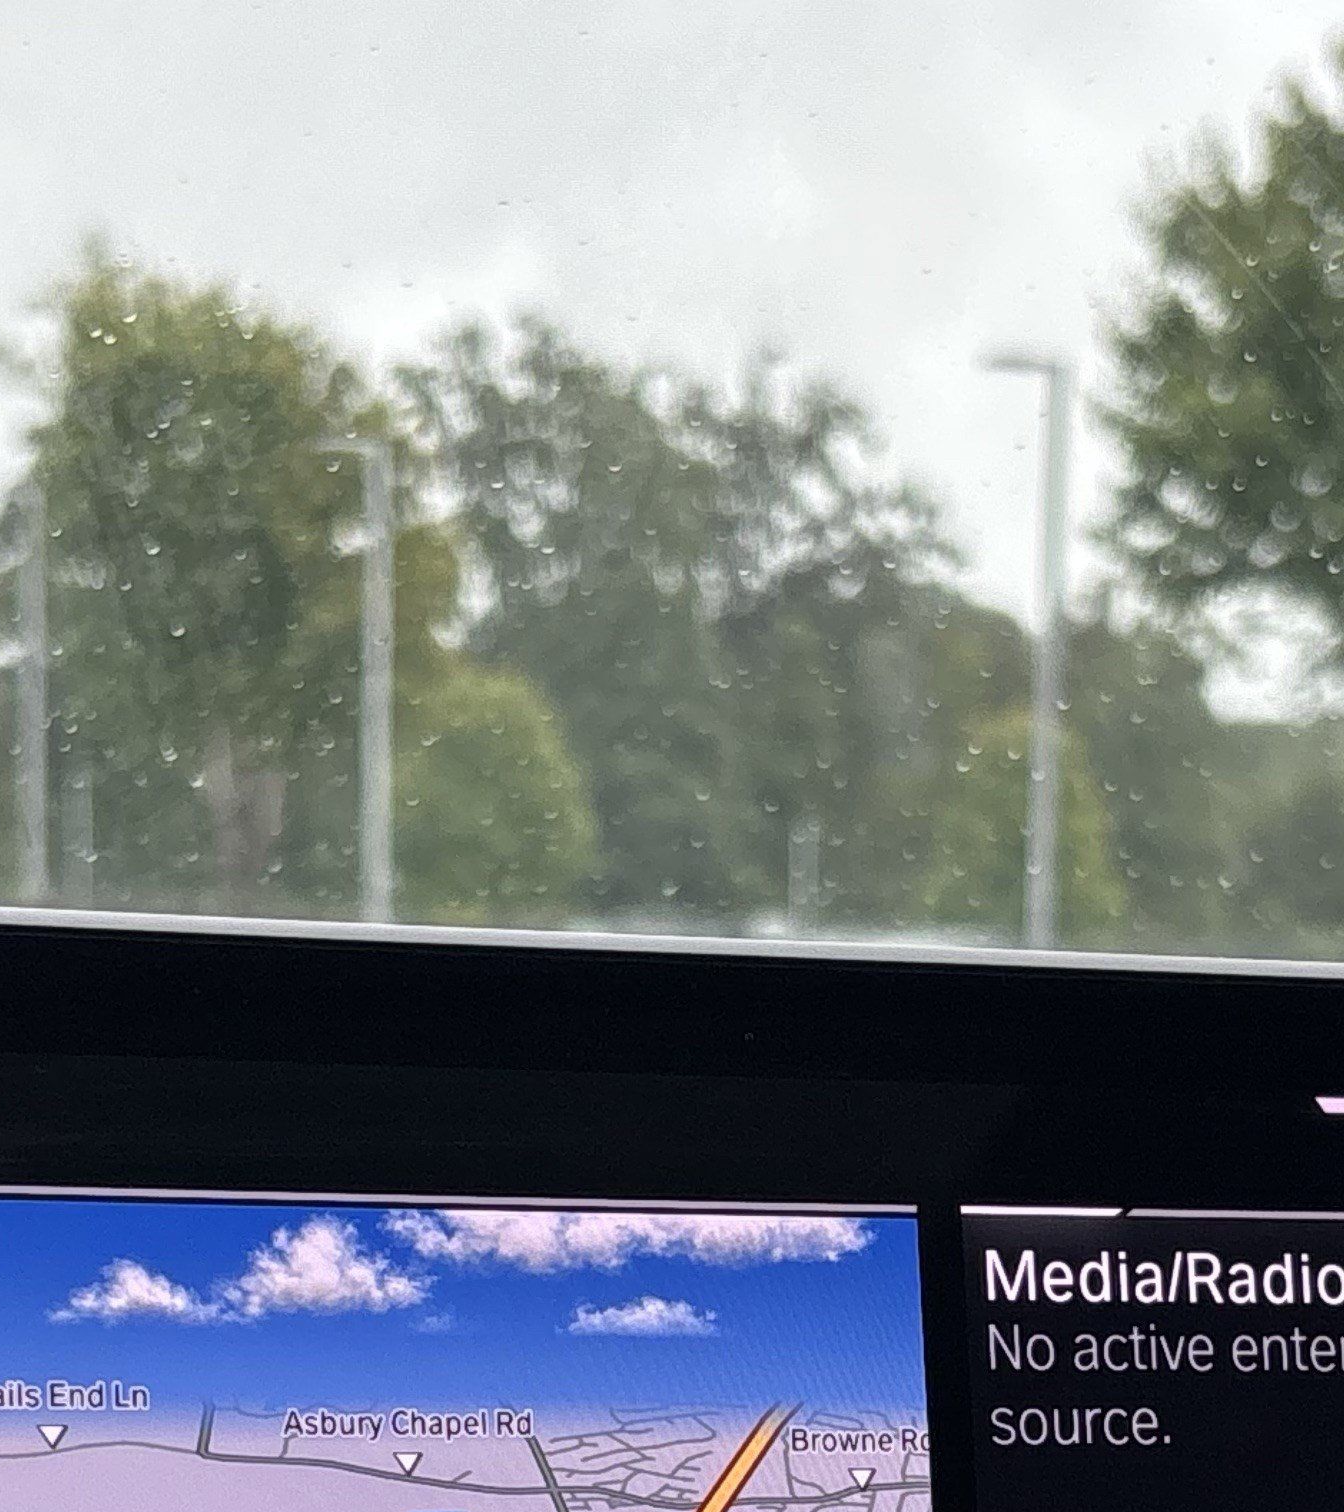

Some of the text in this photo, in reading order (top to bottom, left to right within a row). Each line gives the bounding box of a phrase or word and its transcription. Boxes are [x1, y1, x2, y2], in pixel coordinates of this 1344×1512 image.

[987, 1324, 1054, 1371] No
[1074, 1325, 1213, 1373] active
[49, 1382, 102, 1409] End
[110, 1382, 149, 1409] Ln
[284, 1409, 533, 1440] Asbury Chapel Rd
[790, 1427, 894, 1453] Browne
[990, 1405, 1172, 1446] source.
